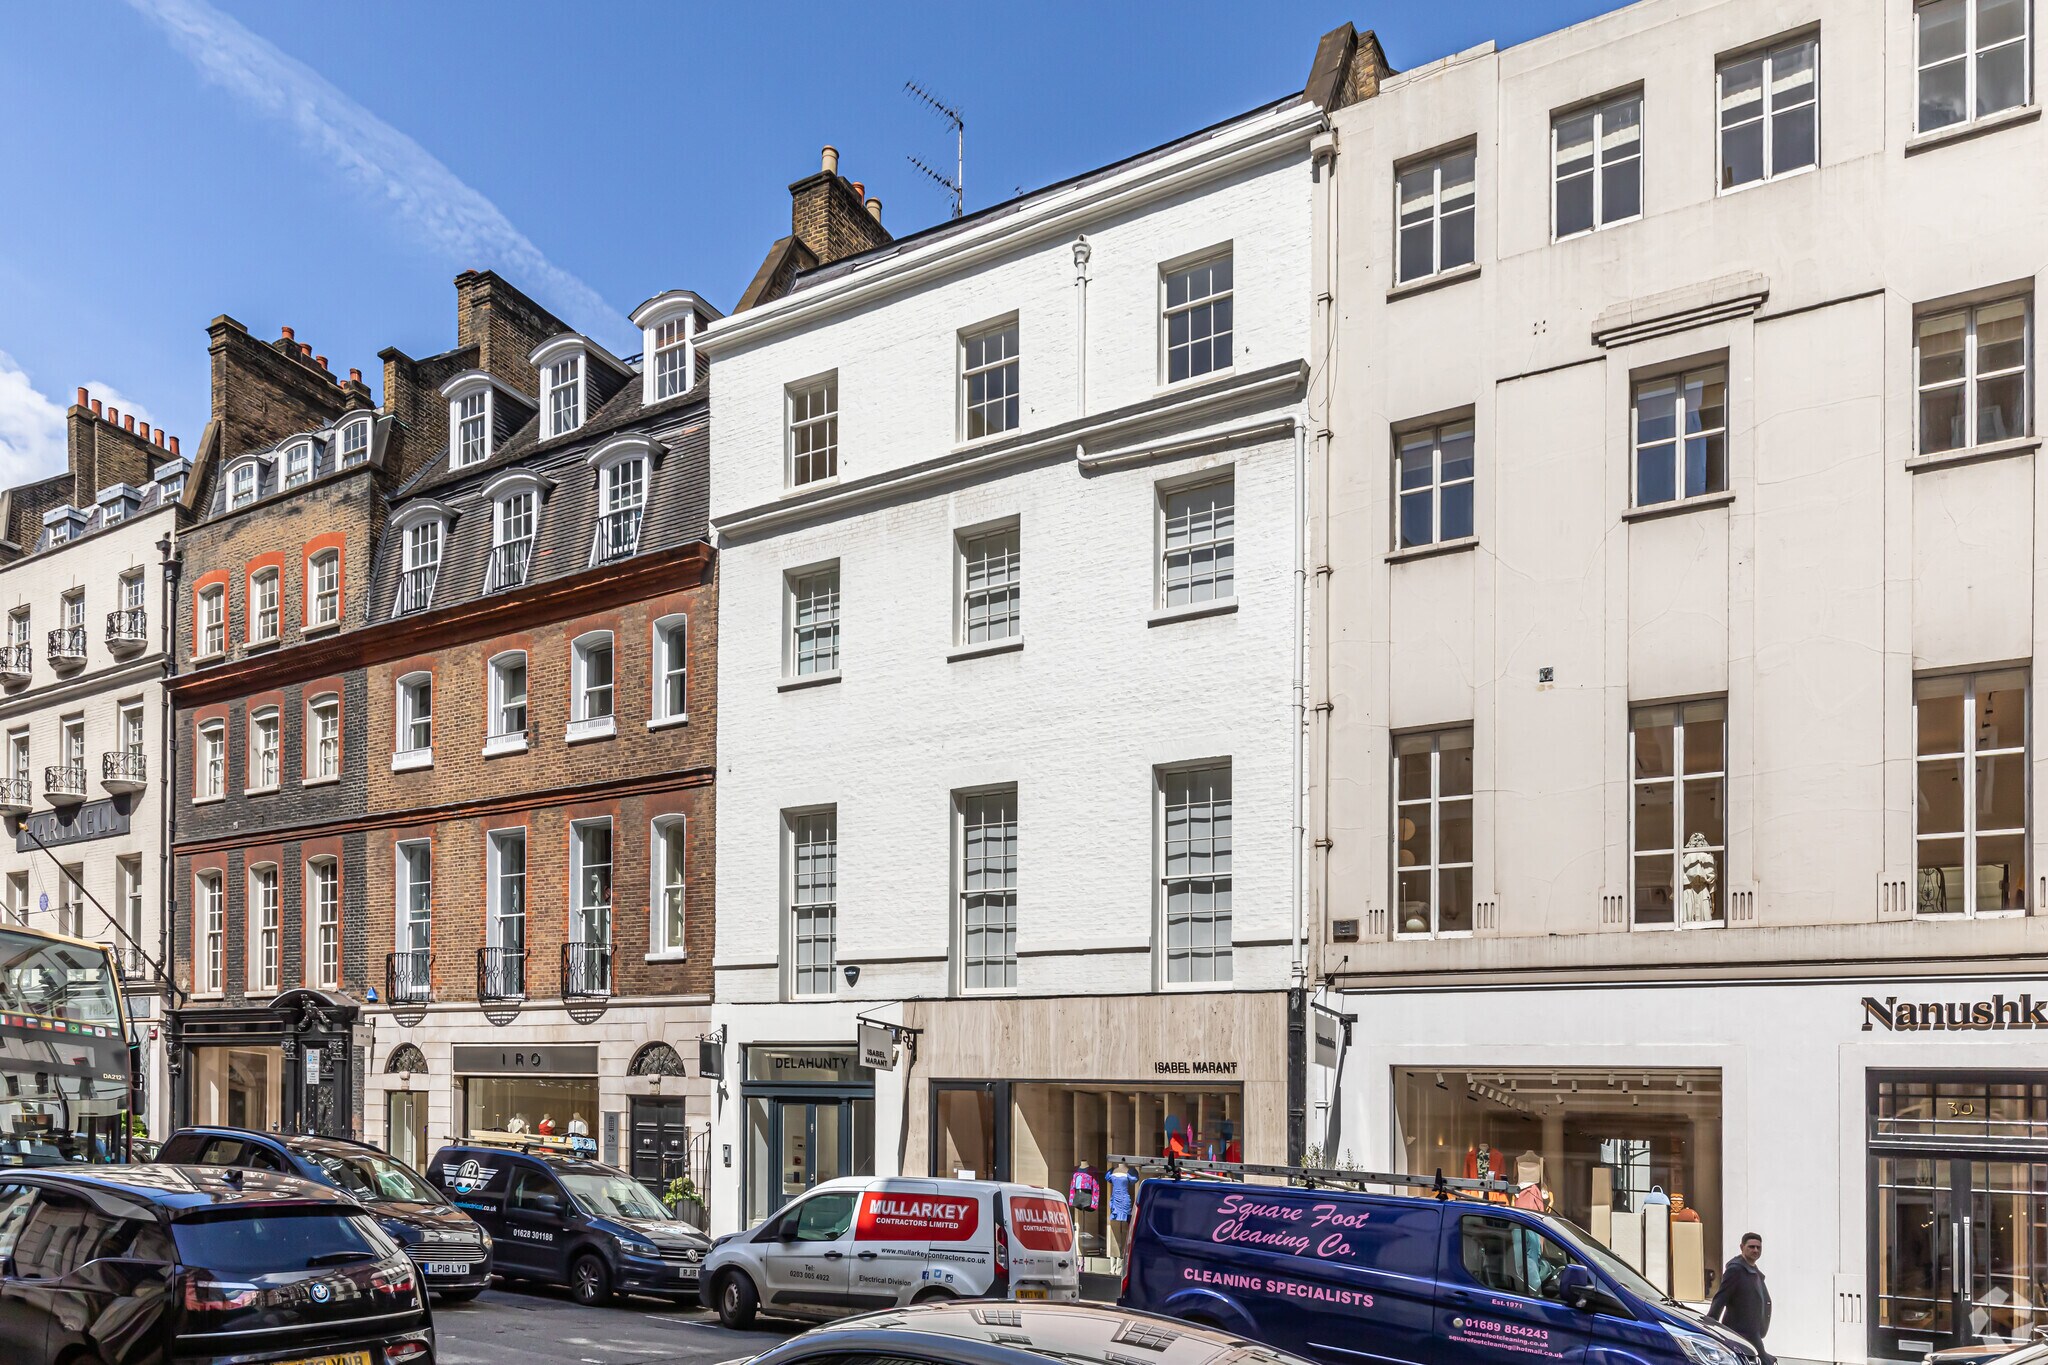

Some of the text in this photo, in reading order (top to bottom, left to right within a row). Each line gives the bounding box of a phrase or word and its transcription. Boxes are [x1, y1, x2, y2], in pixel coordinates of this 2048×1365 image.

[502, 1053, 541, 1067] IRO
[867, 1049, 886, 1059] ISABEL
[775, 1057, 848, 1069] DELAHUNTY
[865, 1057, 888, 1067] MARANT
[1155, 1061, 1238, 1074] ISABEL MARANT
[1947, 1102, 1975, 1117] 30
[460, 1162, 478, 1178] MEL
[869, 1199, 970, 1220] MULLARKEY
[1217, 1194, 1370, 1229] Square Foot
[876, 1217, 959, 1229] CONTRACTORS LIMITED
[1014, 1208, 1068, 1227] MULLARKEY
[1212, 1219, 1356, 1257] Cleaning Co.
[881, 1247, 987, 1265] www.mullarkeycontractors.co.uk
[432, 1264, 467, 1273] LP18 LYD
[805, 1264, 815, 1272] Tel:
[859, 1275, 912, 1287] Electrical Division
[1183, 1268, 1374, 1308] CLEANING SPECIALISTS
[1491, 1299, 1523, 1309] Est.1971
[1465, 1318, 1548, 1340] 01689 854243
[1448, 1334, 1563, 1358] squarefootcleaning@hotmail.co.uk
[1463, 1330, 1549, 1348] squarefootcleaning.co.uk
